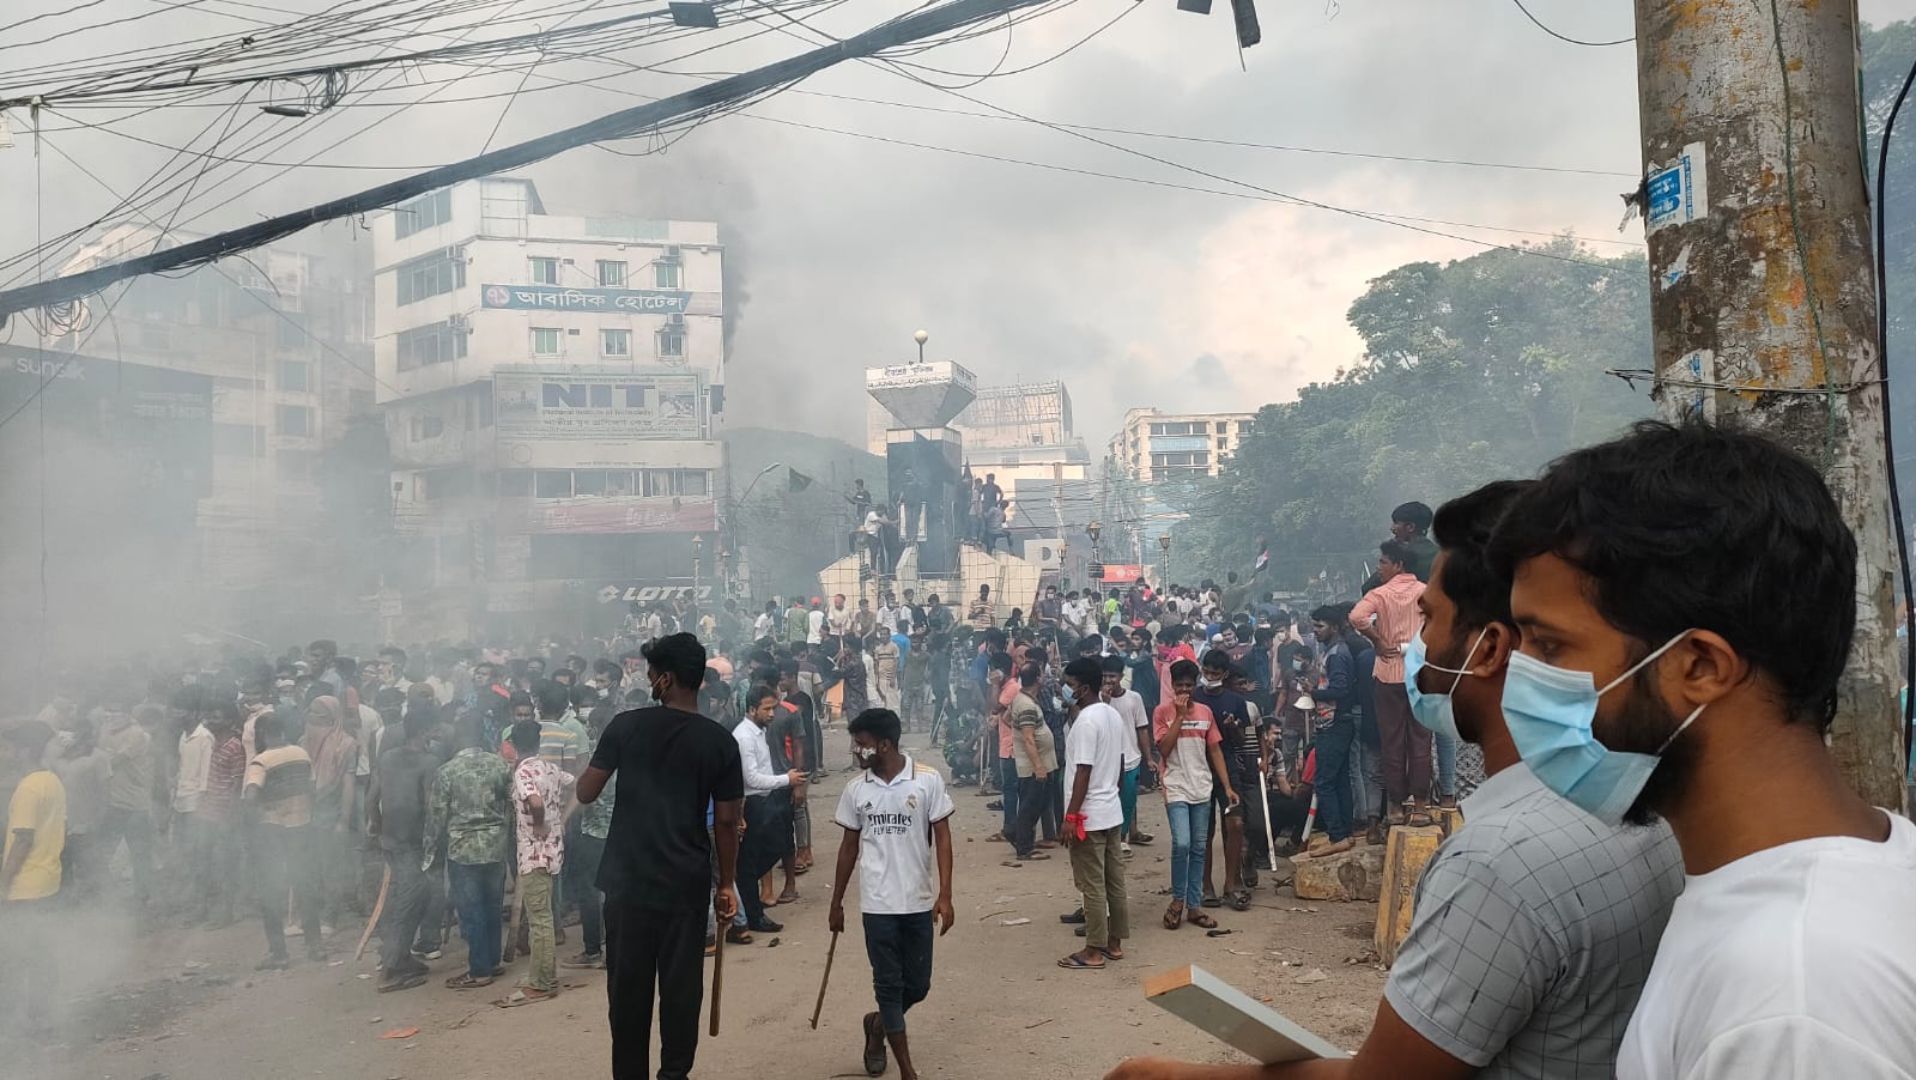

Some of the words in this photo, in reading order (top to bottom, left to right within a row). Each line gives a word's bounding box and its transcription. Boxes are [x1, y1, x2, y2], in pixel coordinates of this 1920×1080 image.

[515, 289, 606, 306] আবাসিক
[615, 293, 684, 311] হোটেল
[543, 383, 656, 408] NIT
[622, 585, 713, 601] LOTTO
